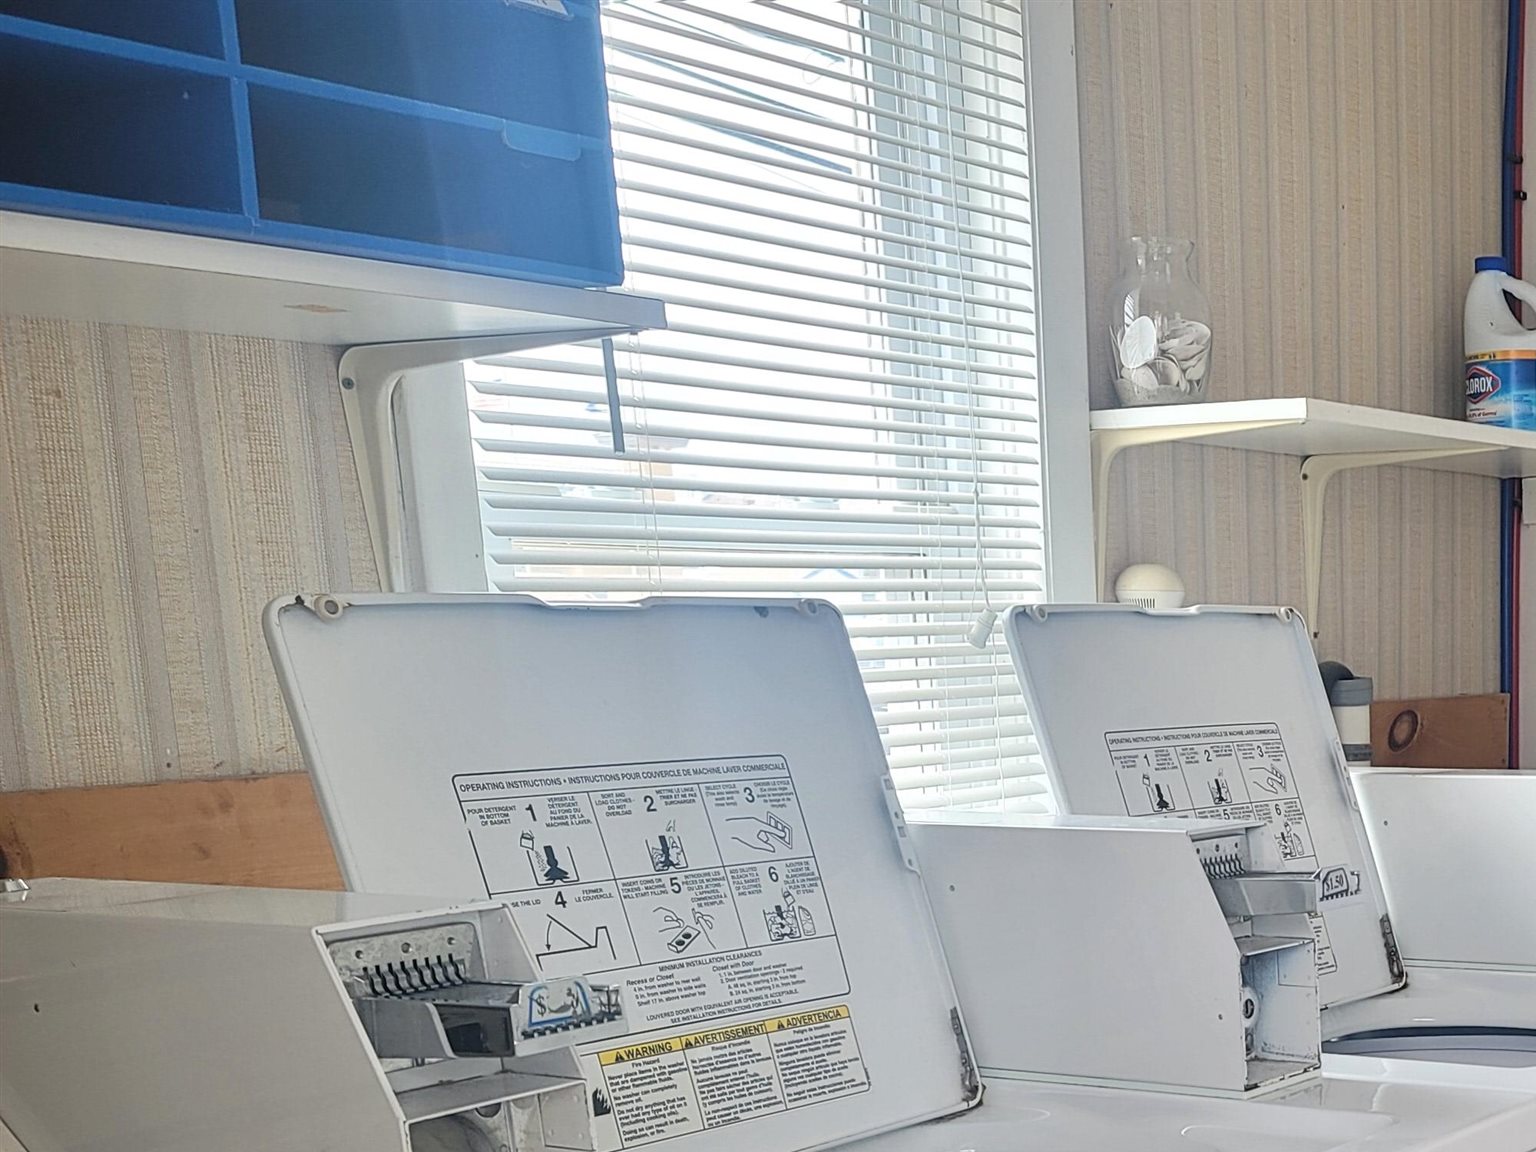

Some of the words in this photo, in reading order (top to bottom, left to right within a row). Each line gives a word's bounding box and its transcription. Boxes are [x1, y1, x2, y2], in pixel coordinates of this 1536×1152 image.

[1204, 749, 1212, 762] 2
[1256, 745, 1264, 758] 3
[460, 781, 505, 792] OPERATING
[506, 777, 562, 789] INSTRUCTIONS
[568, 772, 621, 784] INSTRUCTIONS
[621, 771, 641, 781] POUR
[641, 768, 682, 779] COUVERCLE
[682, 767, 692, 777] DE
[692, 766, 722, 776] MACHINE
[742, 762, 786, 773] COMMERCIALE
[743, 786, 755, 803] 3
[467, 807, 484, 815] POUR
[484, 805, 516, 813] DETERGENT
[643, 795, 657, 812] 2
[1274, 803, 1282, 816] 6
[525, 804, 537, 821] 1
[1223, 809, 1230, 820] 5
[768, 866, 779, 882] 6
[669, 877, 681, 894] 5
[1325, 874, 1344, 892] $1.50
[555, 891, 567, 908] 4
[658, 961, 685, 972] MINIMUM
[685, 956, 725, 968] INSTALLATION
[725, 950, 762, 961] CLEARANCES
[712, 964, 729, 972] Closet
[741, 960, 754, 968] Door
[626, 978, 648, 987] Recess
[656, 973, 674, 981] Closet
[675, 1008, 690, 1016] DOOR
[786, 1008, 842, 1028] ADVERTENCIA
[693, 1023, 765, 1046] AVERTISSEMENT
[624, 1041, 673, 1059] WARNING
